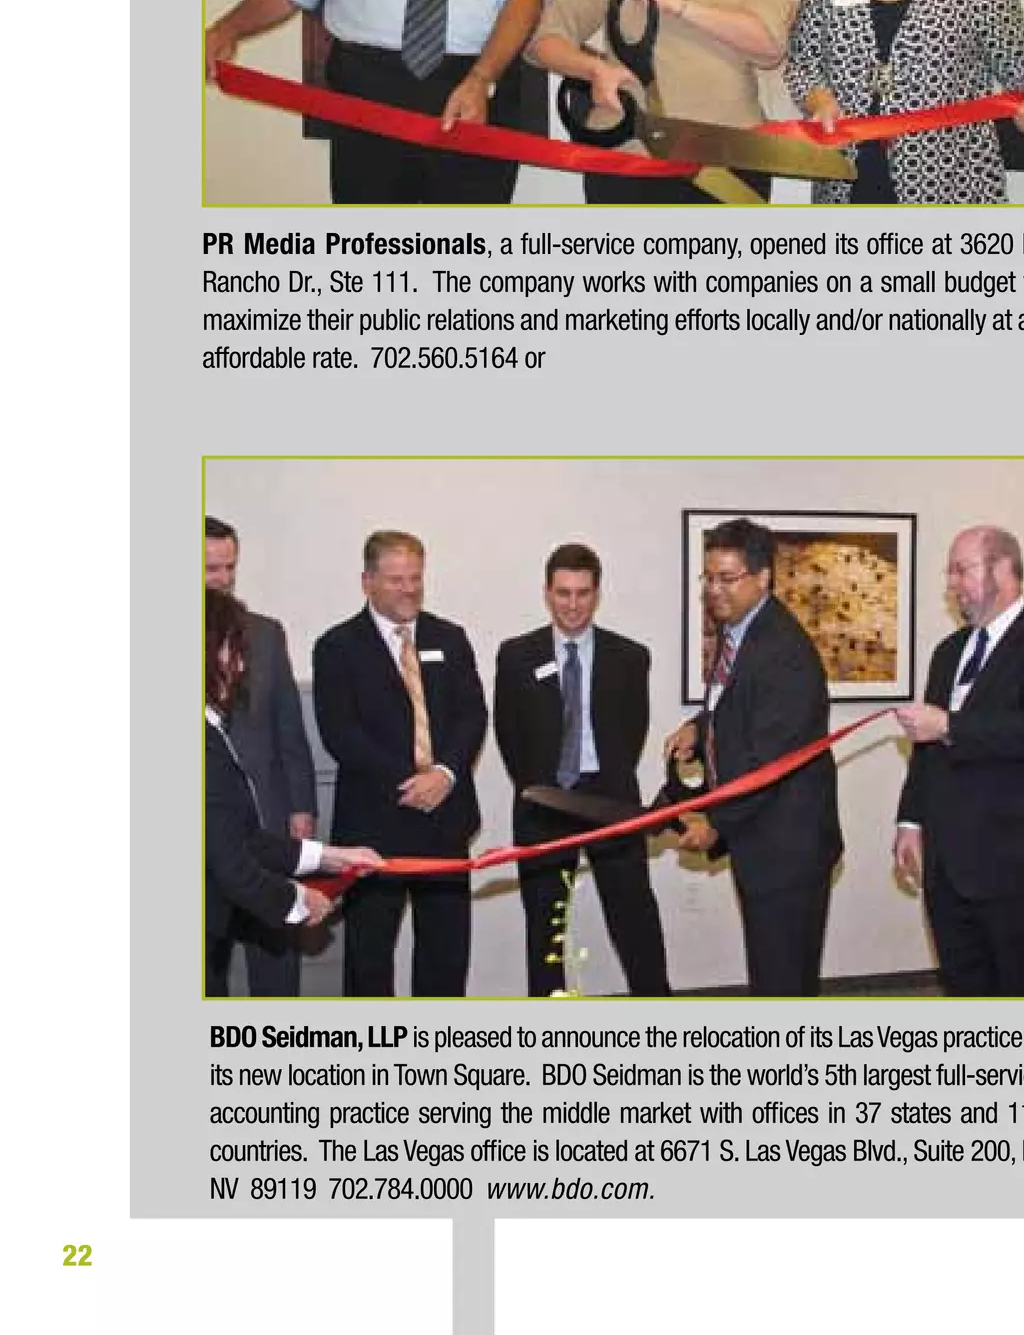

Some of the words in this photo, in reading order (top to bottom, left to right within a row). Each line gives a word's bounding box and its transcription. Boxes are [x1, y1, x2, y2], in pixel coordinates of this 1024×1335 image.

[202, 232, 234, 255] PR
[244, 231, 316, 256] Media
[325, 231, 492, 259] Professionals,
[500, 237, 514, 256] a
[520, 232, 635, 256] full-service
[643, 237, 742, 260] company,
[750, 232, 826, 260] opened
[835, 232, 859, 256] its
[866, 232, 924, 256] office
[931, 232, 953, 256] at
[960, 232, 1014, 256] 3620
[202, 345, 306, 369] affordable
[312, 346, 358, 369] rate.
[370, 346, 519, 369] 702.560.5164
[524, 350, 547, 369] or
[210, 1024, 257, 1049] BDO
[261, 1024, 364, 1053] Seidman,
[368, 1025, 409, 1048] LLP
[413, 1025, 430, 1049] is
[434, 1025, 512, 1053] pleased
[516, 1025, 537, 1049] to
[541, 1030, 641, 1049] announce
[644, 1025, 678, 1049] the
[683, 1025, 780, 1049] relocation
[785, 1025, 806, 1049] of
[810, 1025, 834, 1049] its
[838, 1025, 874, 1049] Las
[876, 1025, 939, 1054] Vegas
[943, 1025, 1023, 1053] practice
[210, 1177, 240, 1200] NV
[250, 1177, 317, 1200] 89119
[328, 1177, 473, 1200] 702.784.0000
[487, 1177, 655, 1200] www.bdo.com.
[62, 1243, 93, 1267] 22
